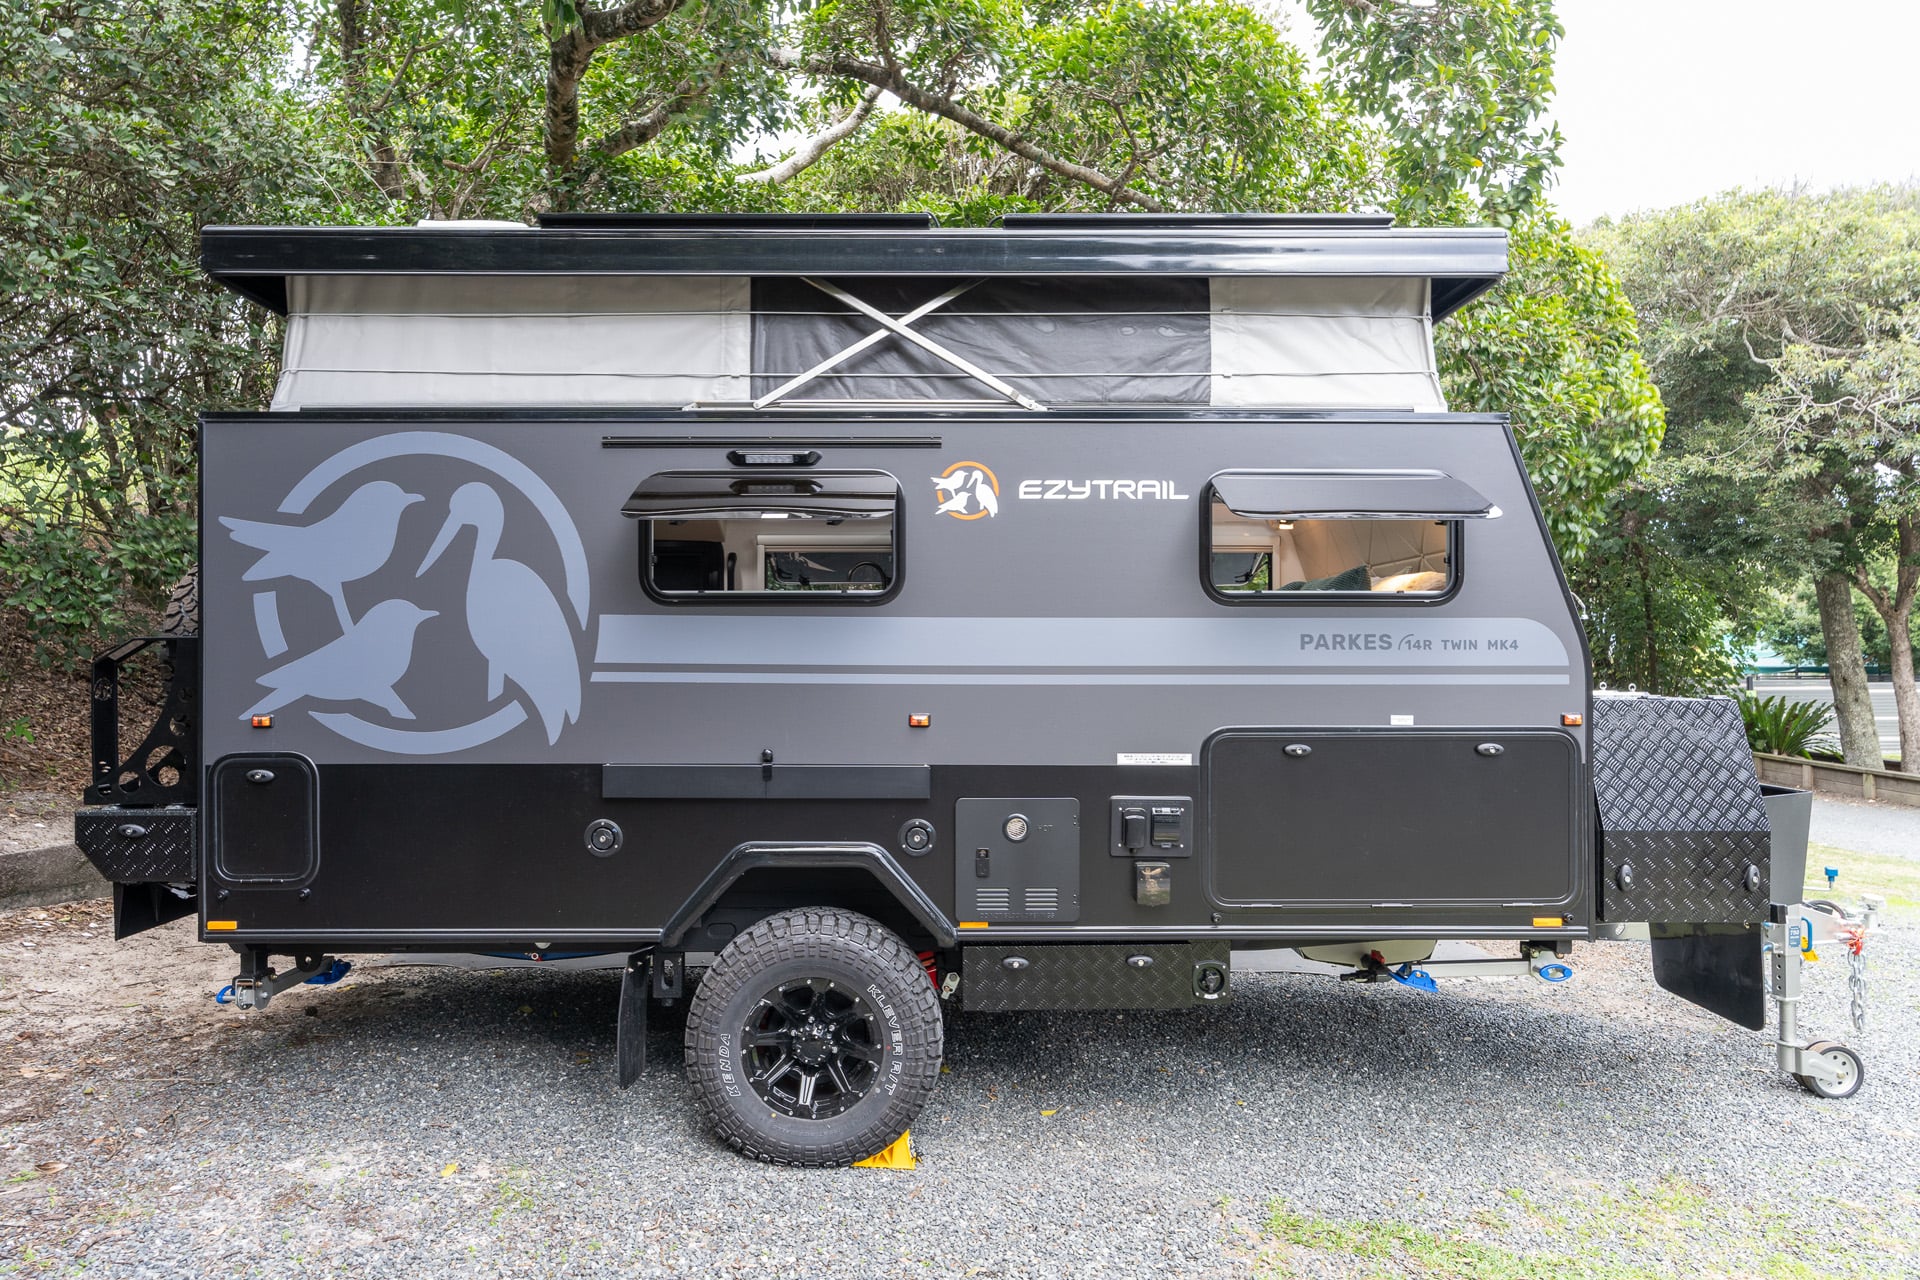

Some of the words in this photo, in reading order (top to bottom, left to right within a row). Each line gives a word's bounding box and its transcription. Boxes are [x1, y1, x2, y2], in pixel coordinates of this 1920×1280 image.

[1018, 479, 1190, 500] EZYTRAIL
[1299, 633, 1393, 651] PARKES
[1404, 639, 1433, 651] 14R
[1441, 639, 1478, 651] TWIN
[1487, 639, 1519, 651] MK4
[867, 984, 903, 1056] KLEVER
[718, 1033, 742, 1097] KENDA
[884, 1060, 903, 1096] R/T
